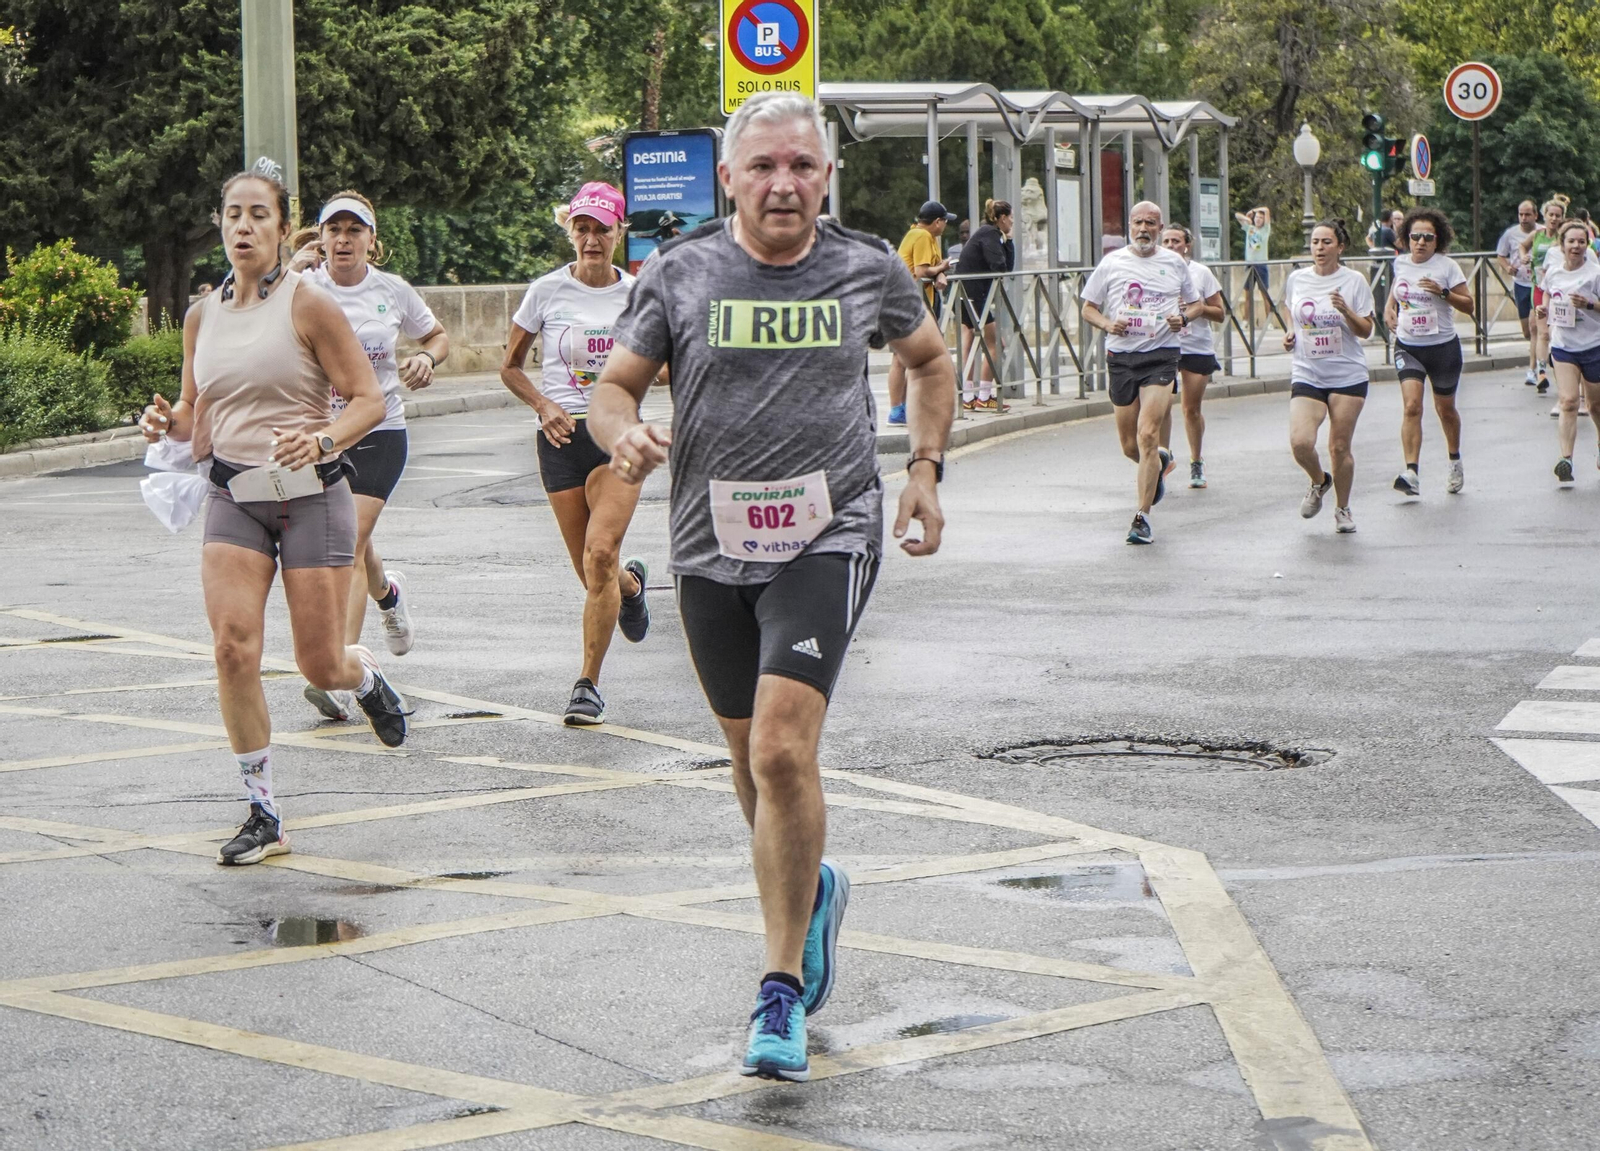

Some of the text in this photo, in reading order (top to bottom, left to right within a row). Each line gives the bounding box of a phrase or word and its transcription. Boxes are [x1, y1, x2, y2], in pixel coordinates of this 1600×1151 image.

[763, 27, 773, 41] P
[755, 47, 782, 57] BUS
[737, 80, 801, 93] SOLO BUS
[1458, 82, 1487, 100] 30
[571, 195, 616, 212] adidas
[707, 299, 719, 347] ACTUALLY
[721, 305, 838, 343] I RUN
[1411, 316, 1427, 326] 549
[1315, 336, 1329, 347] 311
[732, 487, 805, 501] COVIRAN
[747, 504, 796, 530] 602
[762, 539, 808, 553] vithas
